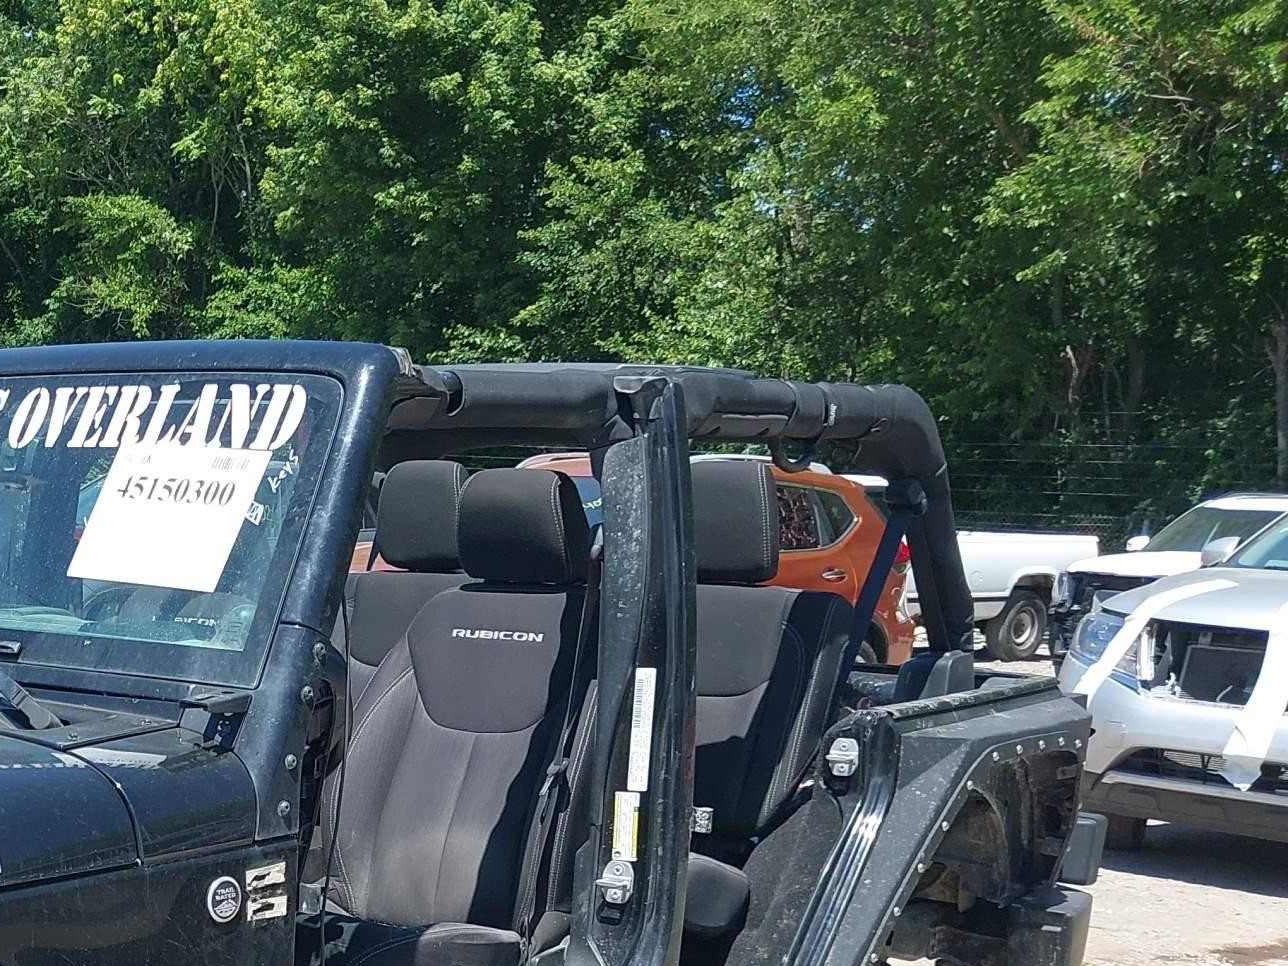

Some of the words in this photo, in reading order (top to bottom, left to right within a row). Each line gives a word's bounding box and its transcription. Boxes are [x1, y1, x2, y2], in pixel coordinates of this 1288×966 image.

[8, 382, 308, 452] OVERLAND
[116, 474, 236, 507] 45150300
[451, 628, 545, 643] RUBICON
[214, 892, 237, 901] RATED
[215, 886, 236, 896] TRAIL
